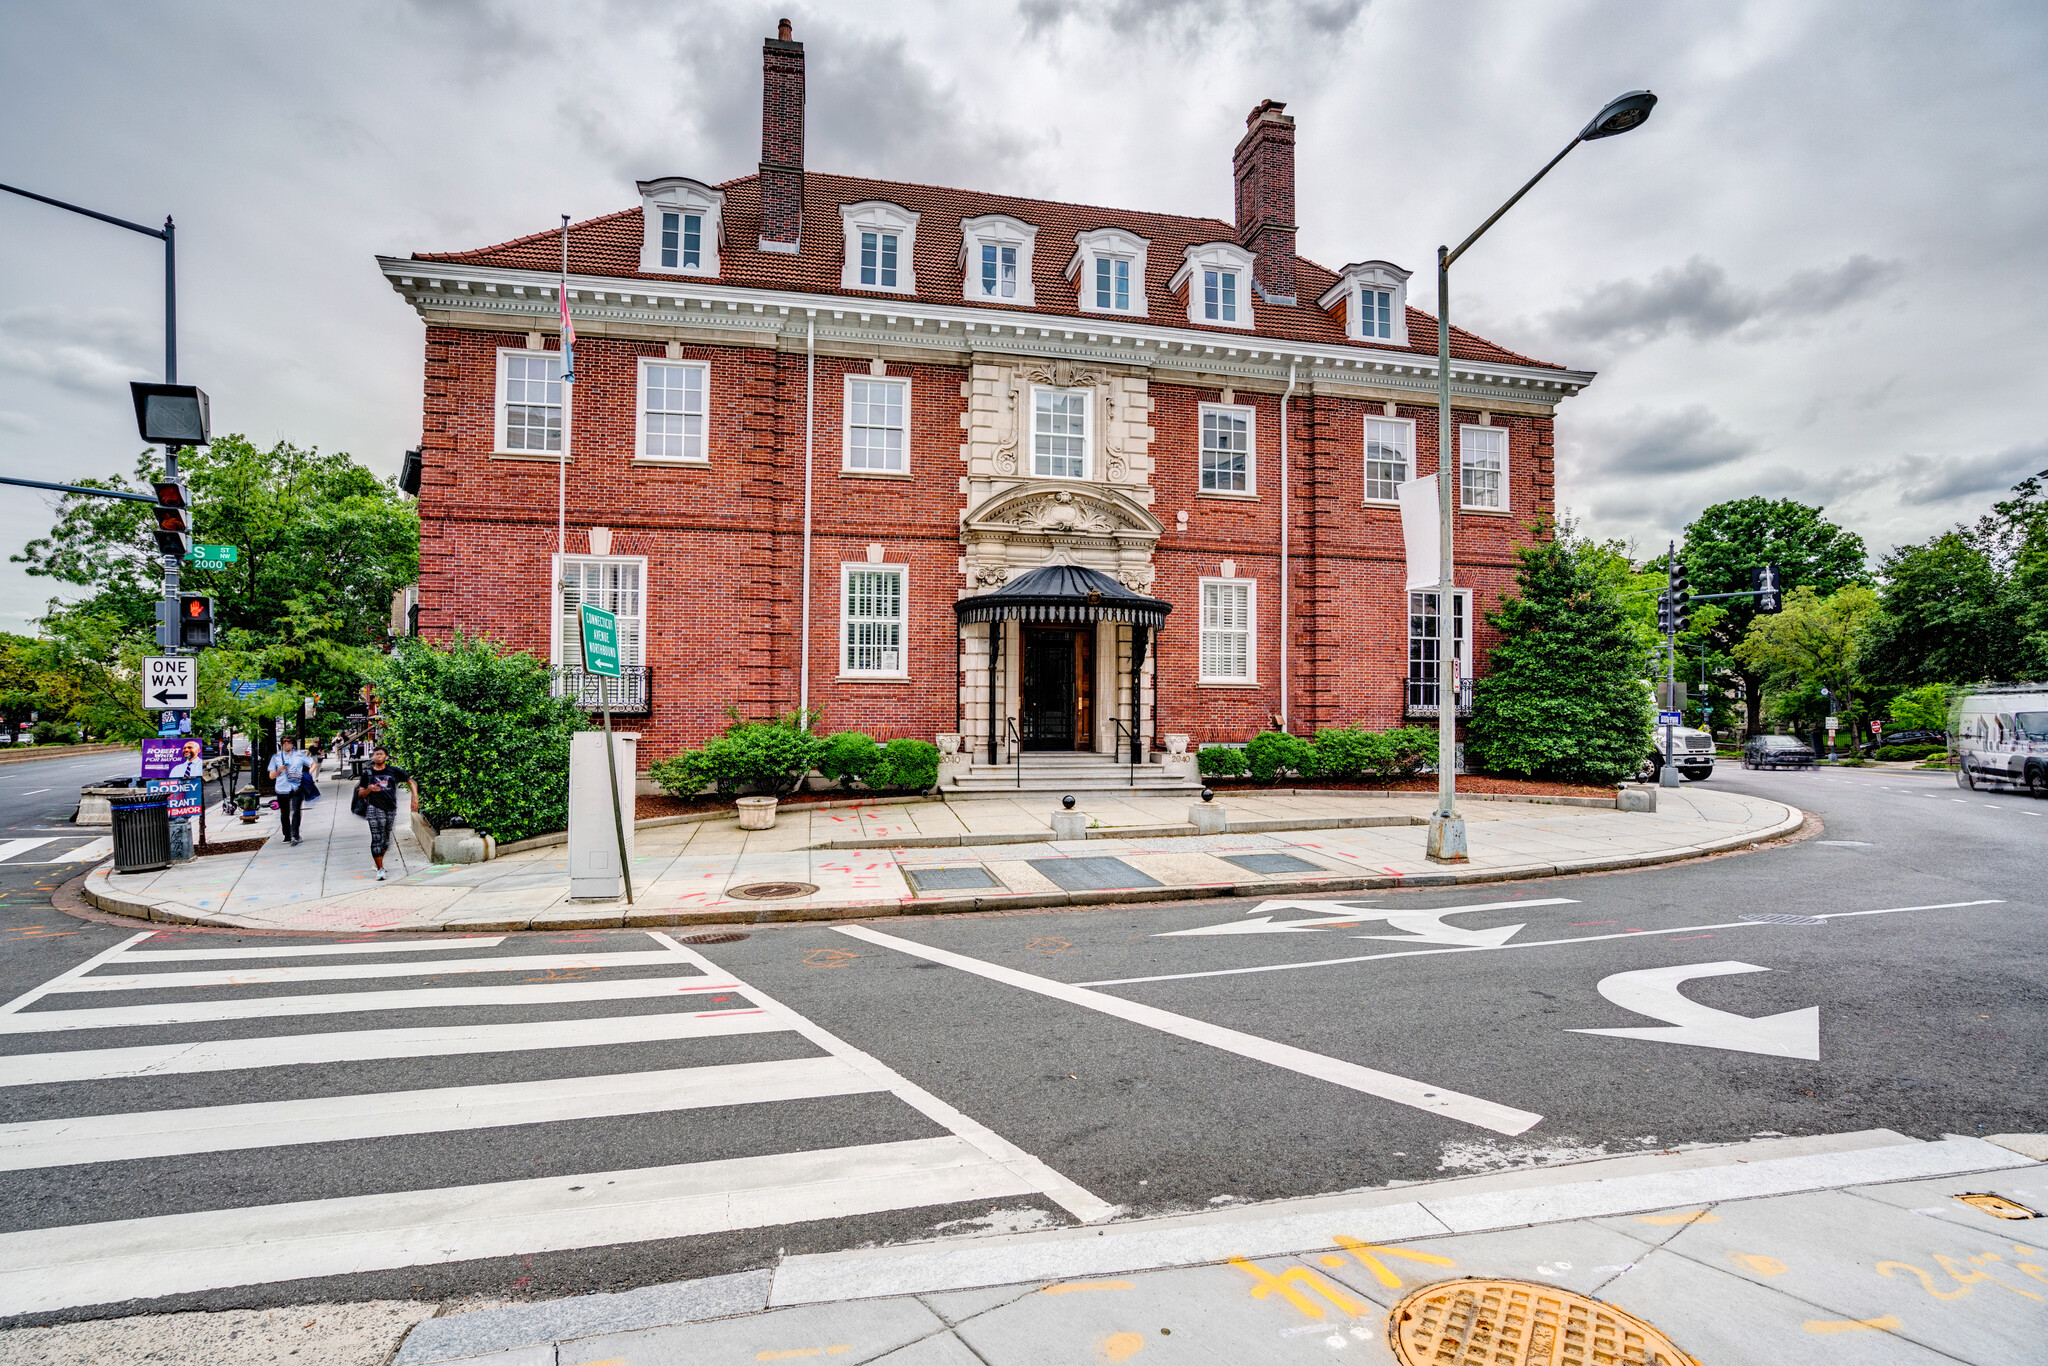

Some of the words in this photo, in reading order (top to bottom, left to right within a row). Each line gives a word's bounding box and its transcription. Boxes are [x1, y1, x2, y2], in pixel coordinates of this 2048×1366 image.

[194, 546, 206, 558] S
[195, 559, 223, 569] 2000
[586, 613, 613, 630] CONNECTICUT
[593, 629, 610, 644] AVENUE
[589, 641, 616, 658] NORTHBOUND
[153, 661, 187, 673] ONE
[152, 674, 188, 687] WAY
[1171, 755, 1191, 763] 2040
[150, 783, 198, 793] RODNEY
[167, 797, 197, 808] RANT
[177, 806, 201, 815] MAYOR
